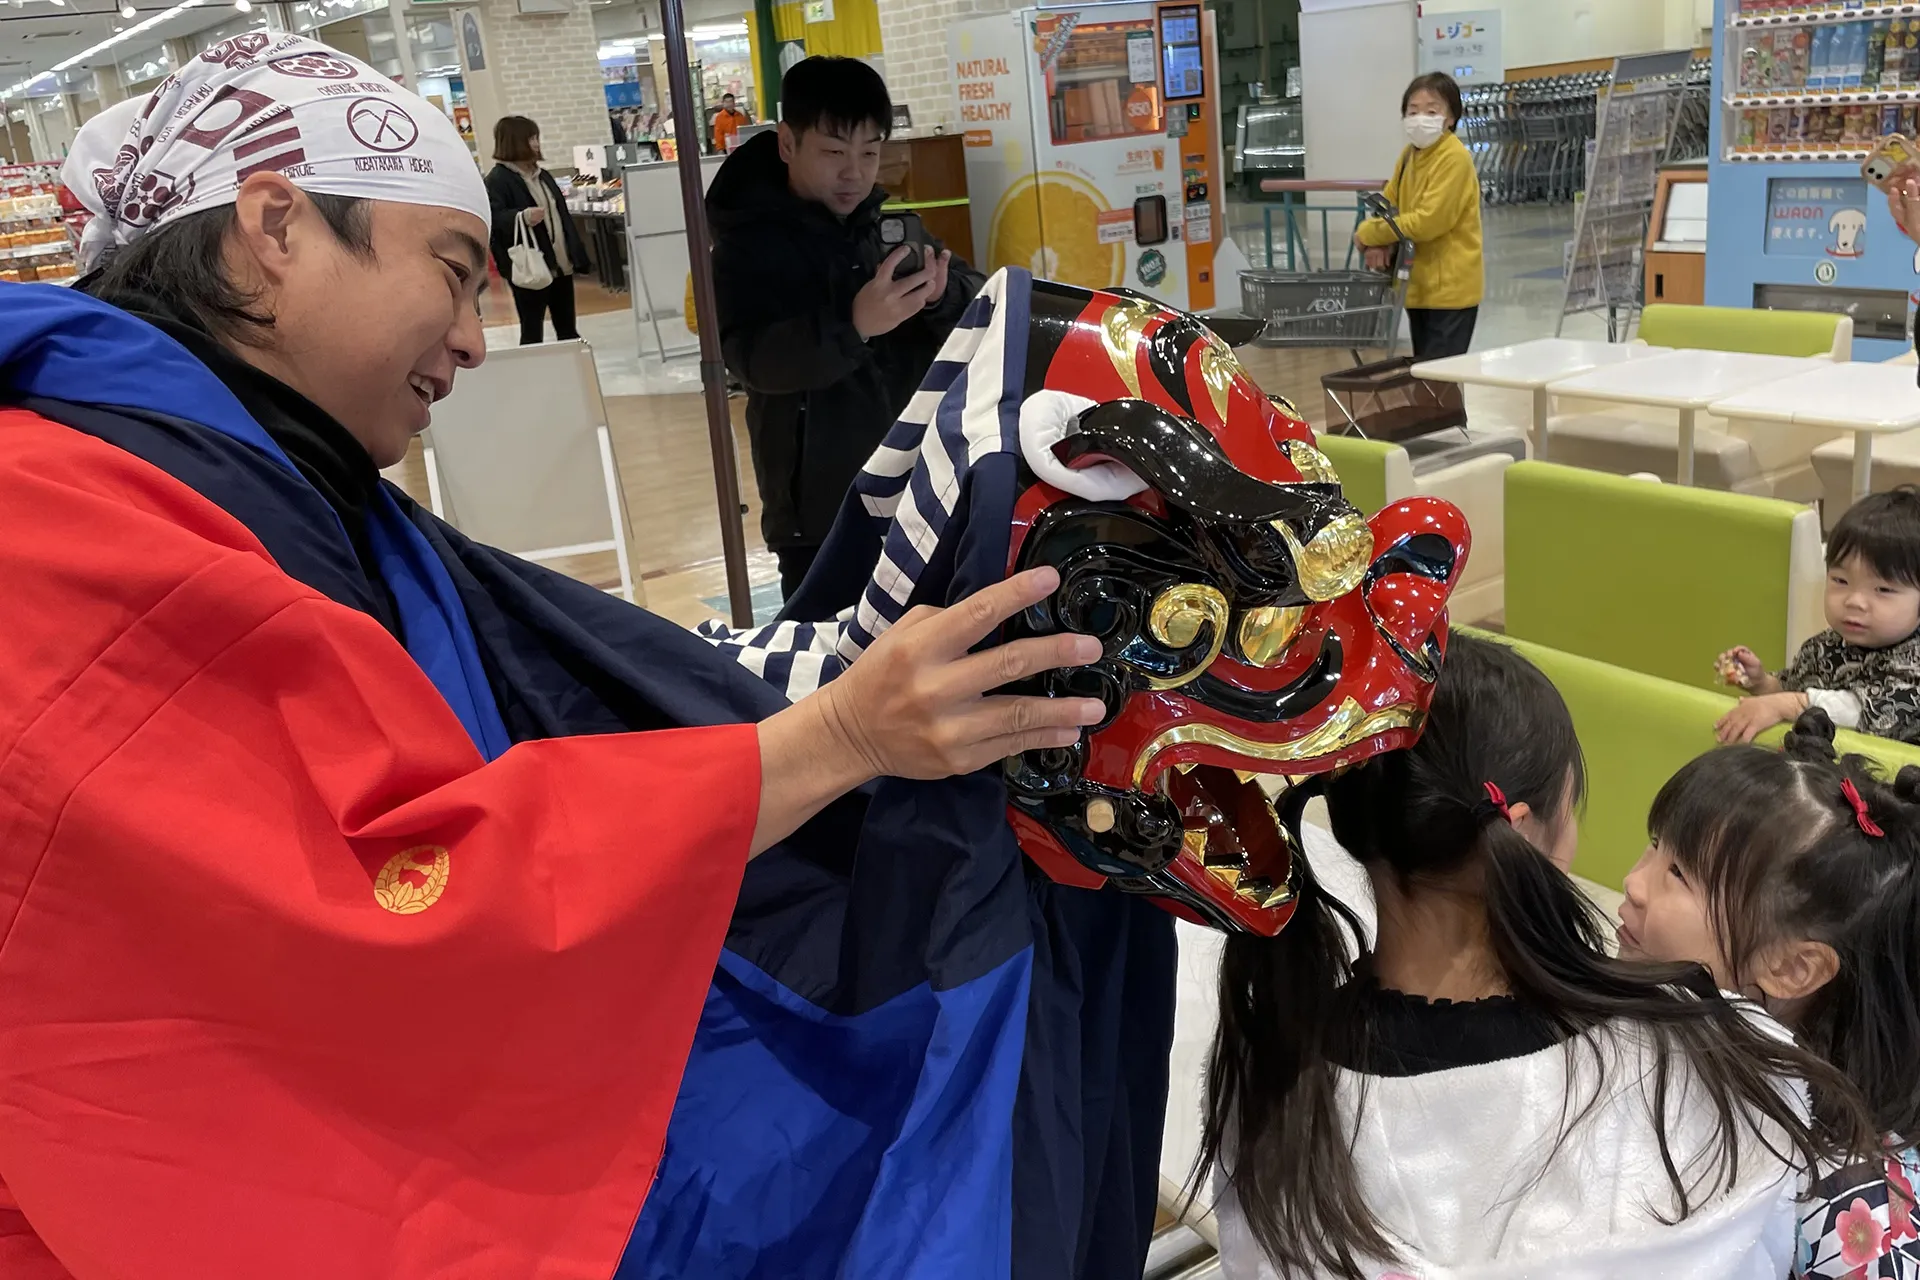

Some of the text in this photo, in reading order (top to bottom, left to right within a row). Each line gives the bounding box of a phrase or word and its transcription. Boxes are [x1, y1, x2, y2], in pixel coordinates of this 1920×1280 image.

[1436, 21, 1485, 40] レジゴー
[957, 57, 1010, 79] NATURAL
[958, 82, 995, 101] FRESH
[960, 102, 1012, 122] HEALTHY
[1127, 101, 1152, 117] 350
[157, 125, 175, 144] ODA
[1774, 206, 1824, 219] WAON
